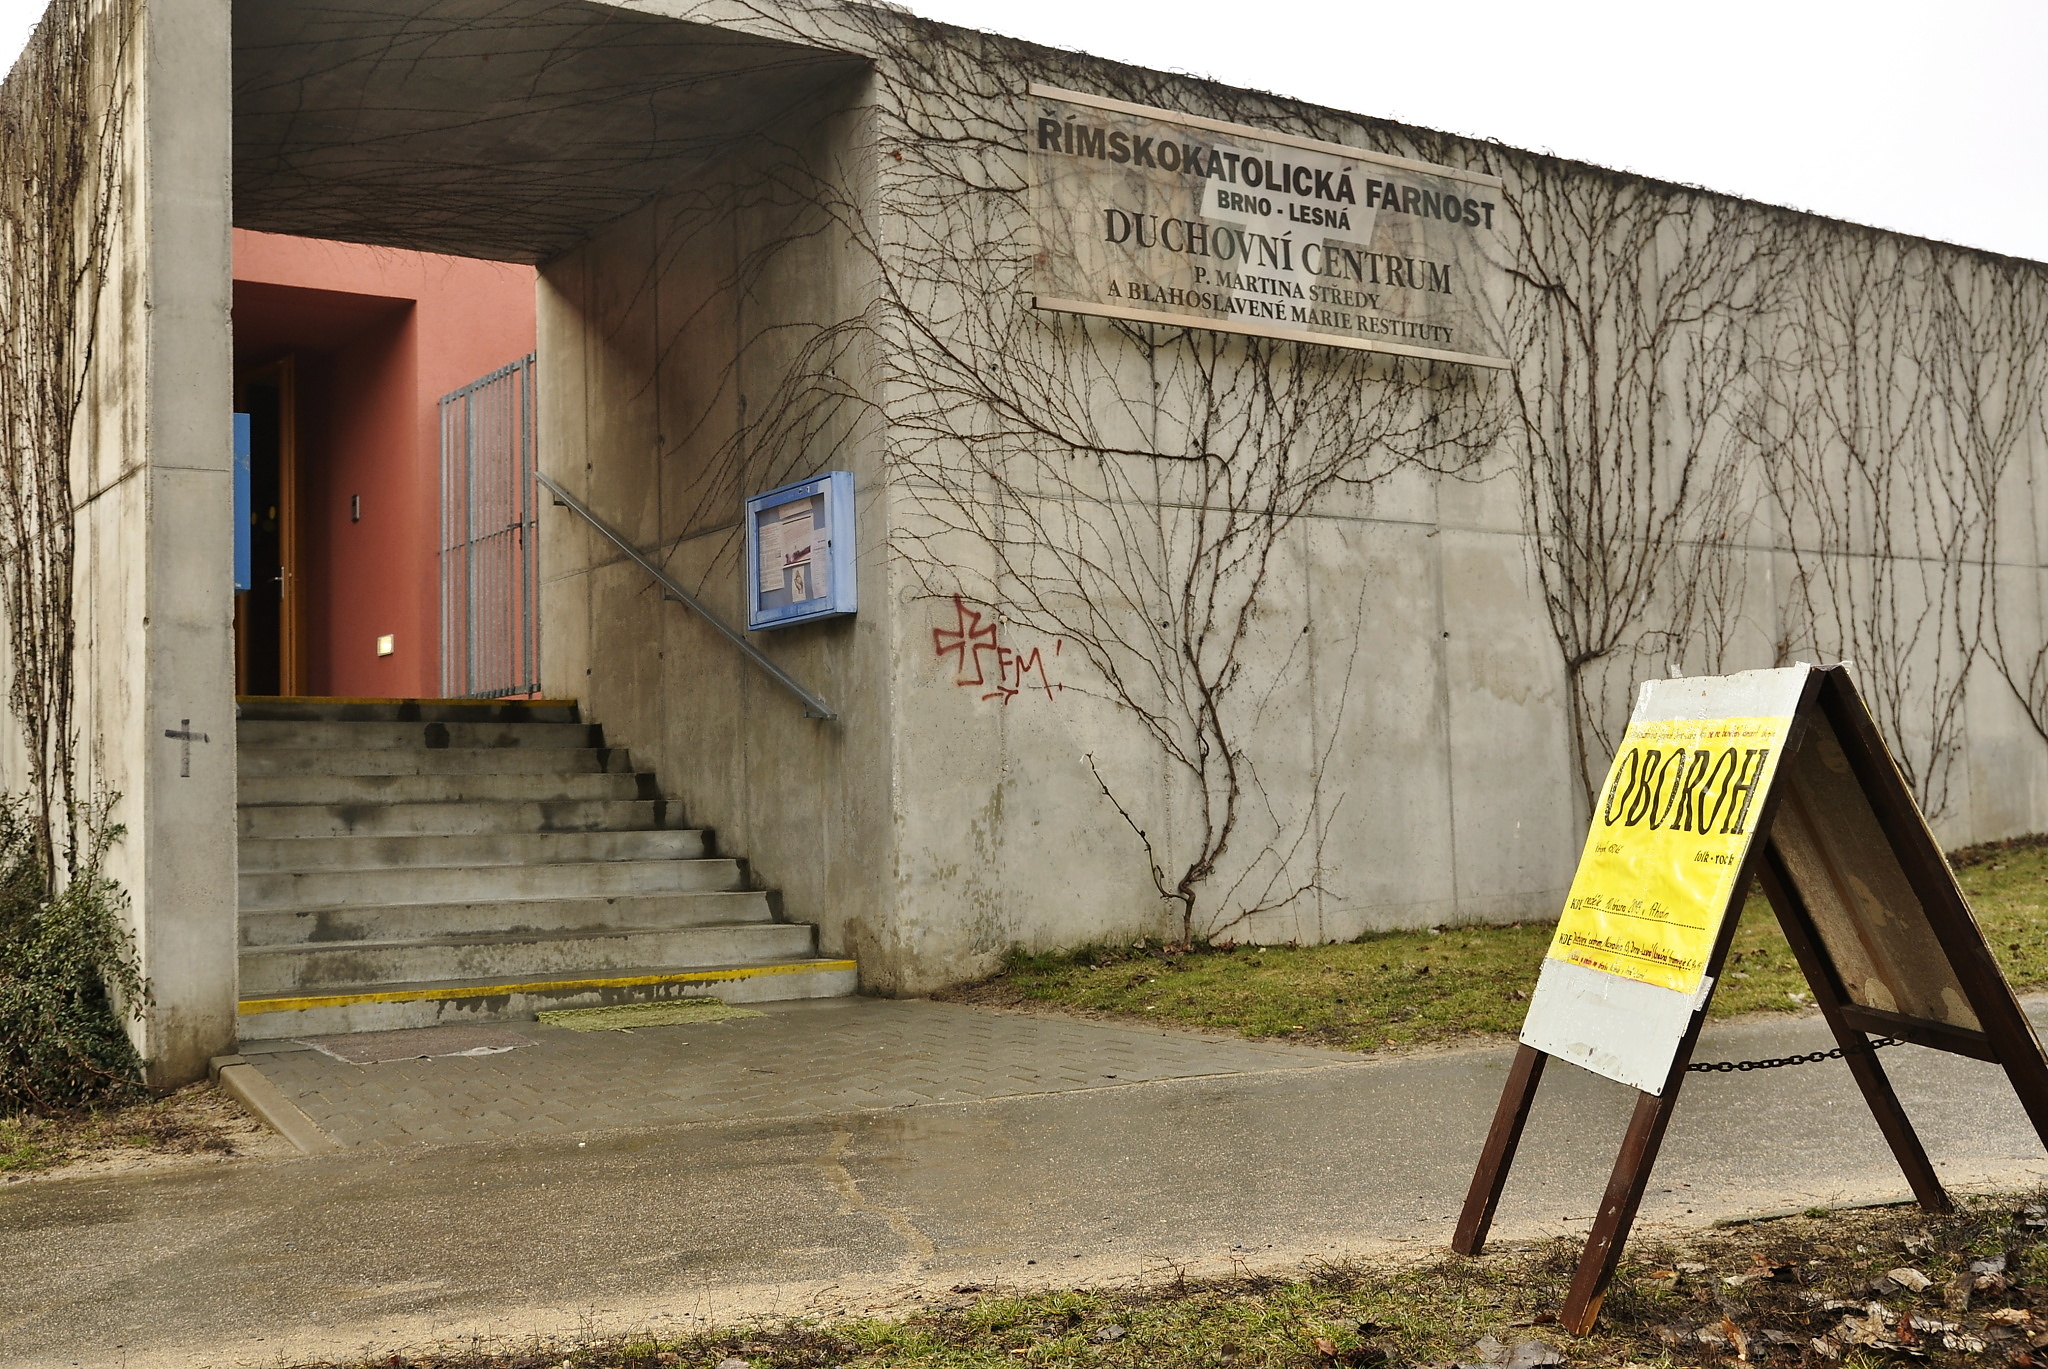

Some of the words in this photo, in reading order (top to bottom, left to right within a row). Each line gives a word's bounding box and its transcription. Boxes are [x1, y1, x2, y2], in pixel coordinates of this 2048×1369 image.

[1038, 108, 1356, 205] ŘÍMSKOKATOLICKÁ
[1366, 179, 1495, 230] FARNOST
[1217, 189, 1272, 217] BRNO
[1289, 203, 1351, 230] LESNÁ
[1103, 208, 1294, 271] DUCHOVNÍ
[1301, 242, 1453, 295] CENTRUM
[1107, 279, 1122, 298] A
[1128, 282, 1287, 321] BLAHOSLAVENÉ
[1291, 305, 1353, 330] MARIE
[1356, 315, 1454, 344] RESTITUTY
[1194, 266, 1211, 285] P.
[1216, 269, 1305, 299] MARTINA
[1309, 282, 1380, 310] STŘEDY
[1604, 747, 1770, 836] OBOROH
[1694, 850, 1710, 863] folk
[1715, 852, 1735, 866] rock
